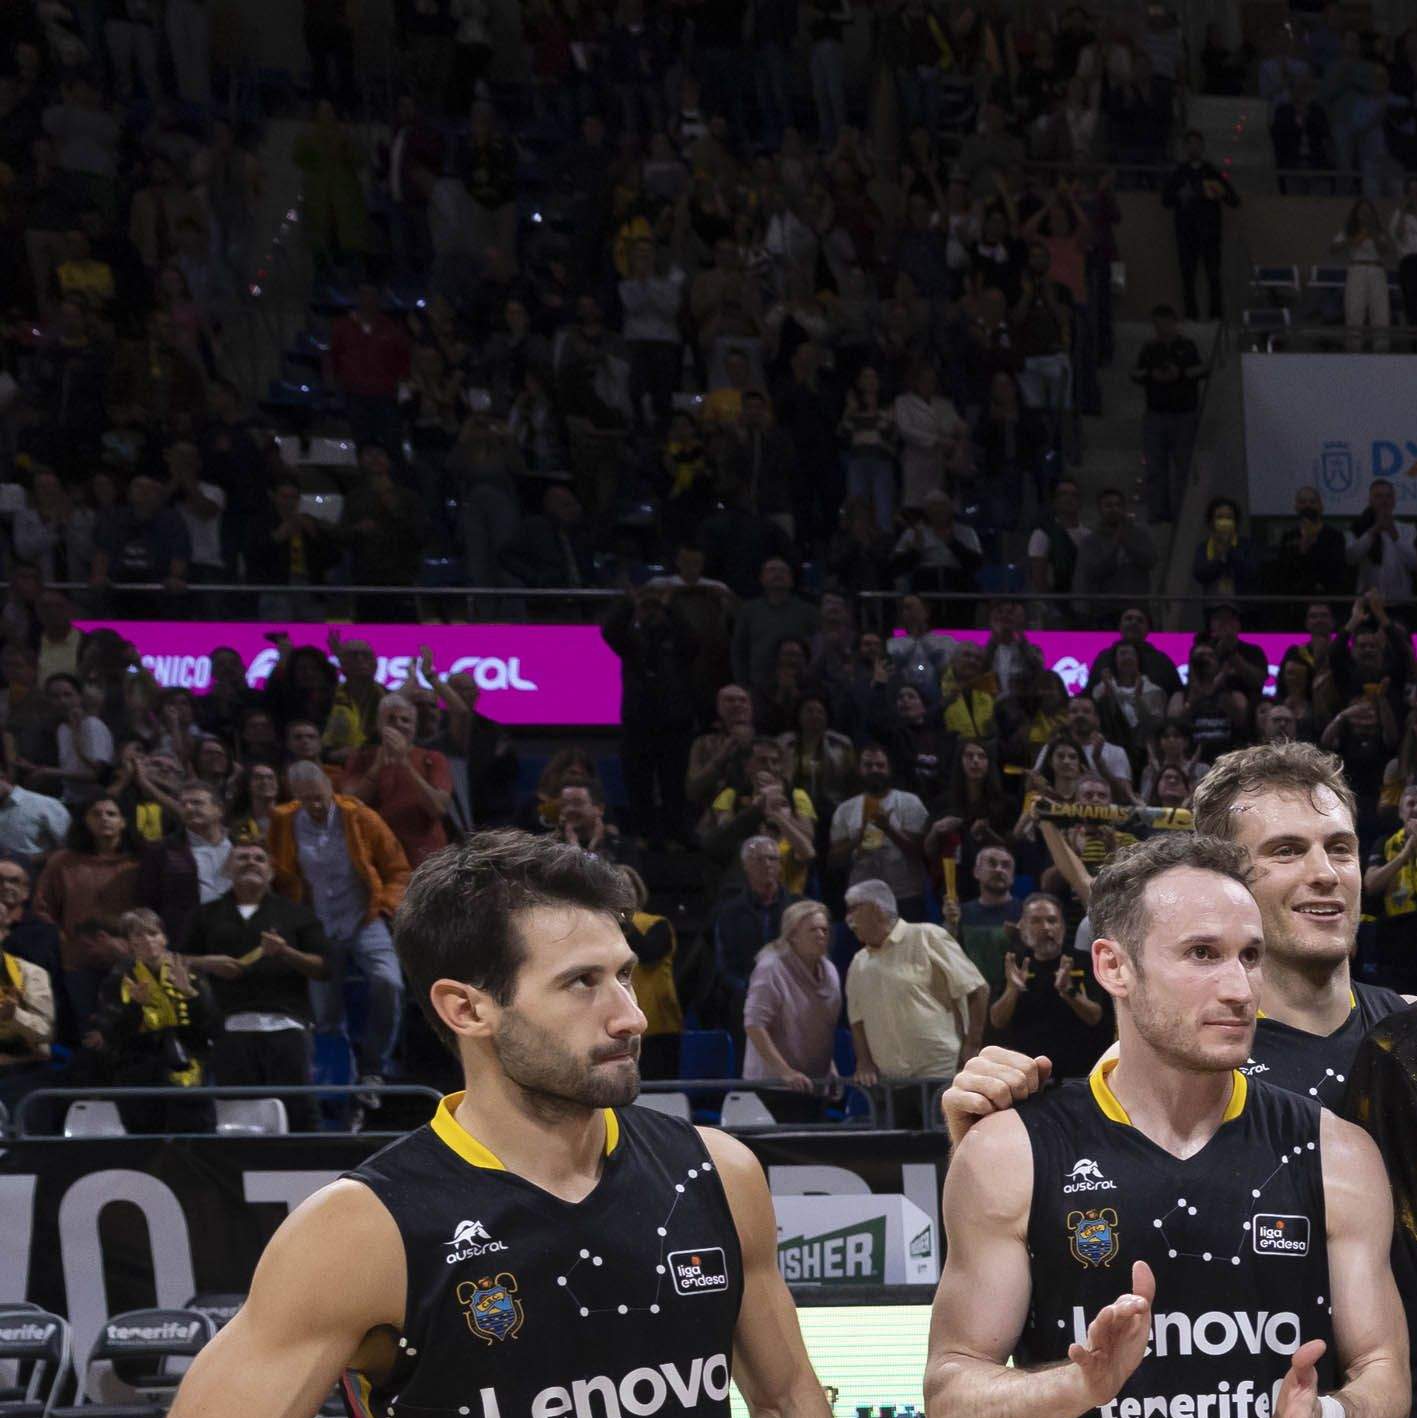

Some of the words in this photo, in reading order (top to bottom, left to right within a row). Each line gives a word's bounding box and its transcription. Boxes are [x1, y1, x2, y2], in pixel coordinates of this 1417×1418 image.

[1063, 1179, 1117, 1194] austral
[1259, 1226, 1282, 1240] liga
[1259, 1236, 1306, 1251] endesa
[446, 1240, 508, 1265] austral
[778, 1231, 875, 1281] ISHER
[677, 1263, 702, 1278] liga
[681, 1273, 726, 1289] endesa
[108, 1321, 201, 1340] tenerife!
[1073, 1304, 1301, 1358] Lnovo
